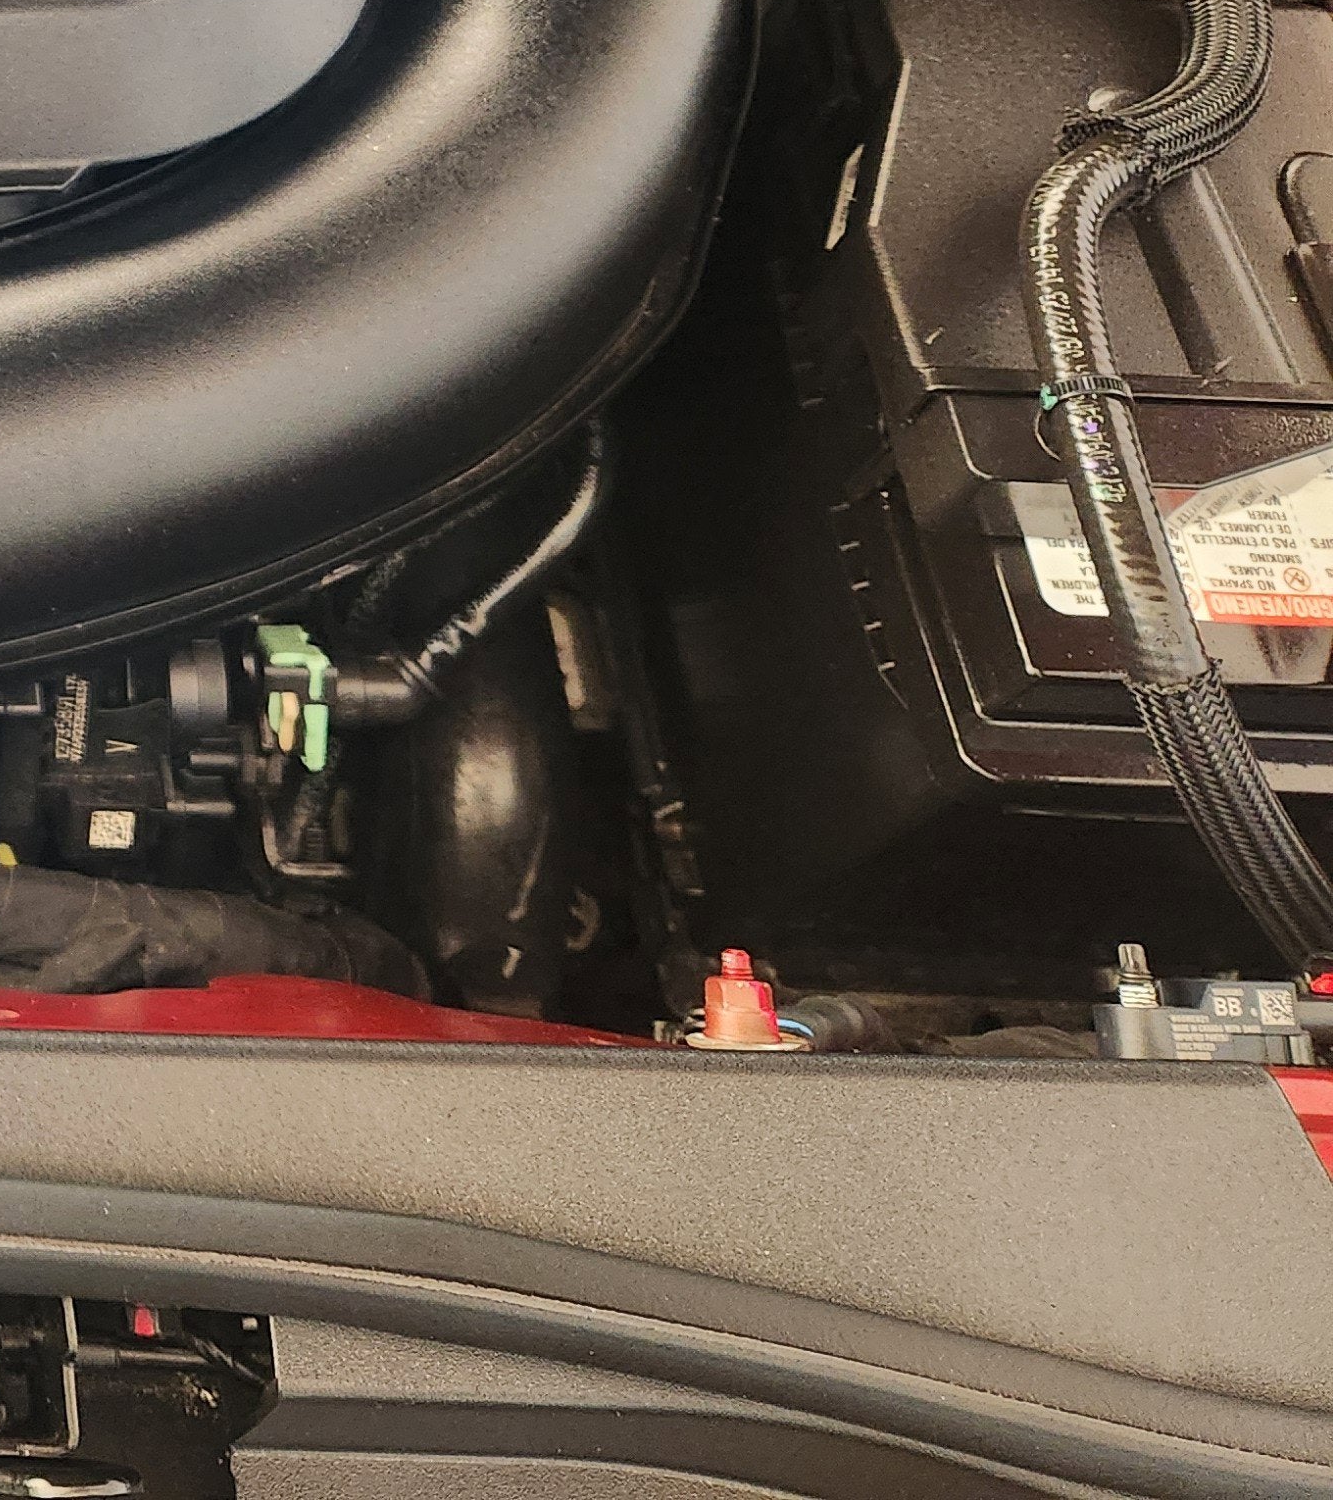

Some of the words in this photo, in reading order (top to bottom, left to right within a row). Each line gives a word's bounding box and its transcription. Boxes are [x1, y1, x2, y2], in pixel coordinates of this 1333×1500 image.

[1272, 537, 1297, 549] PAS
[1249, 553, 1302, 564] SMOKING
[1258, 581, 1277, 591] NO
[1212, 996, 1243, 1017] BB
